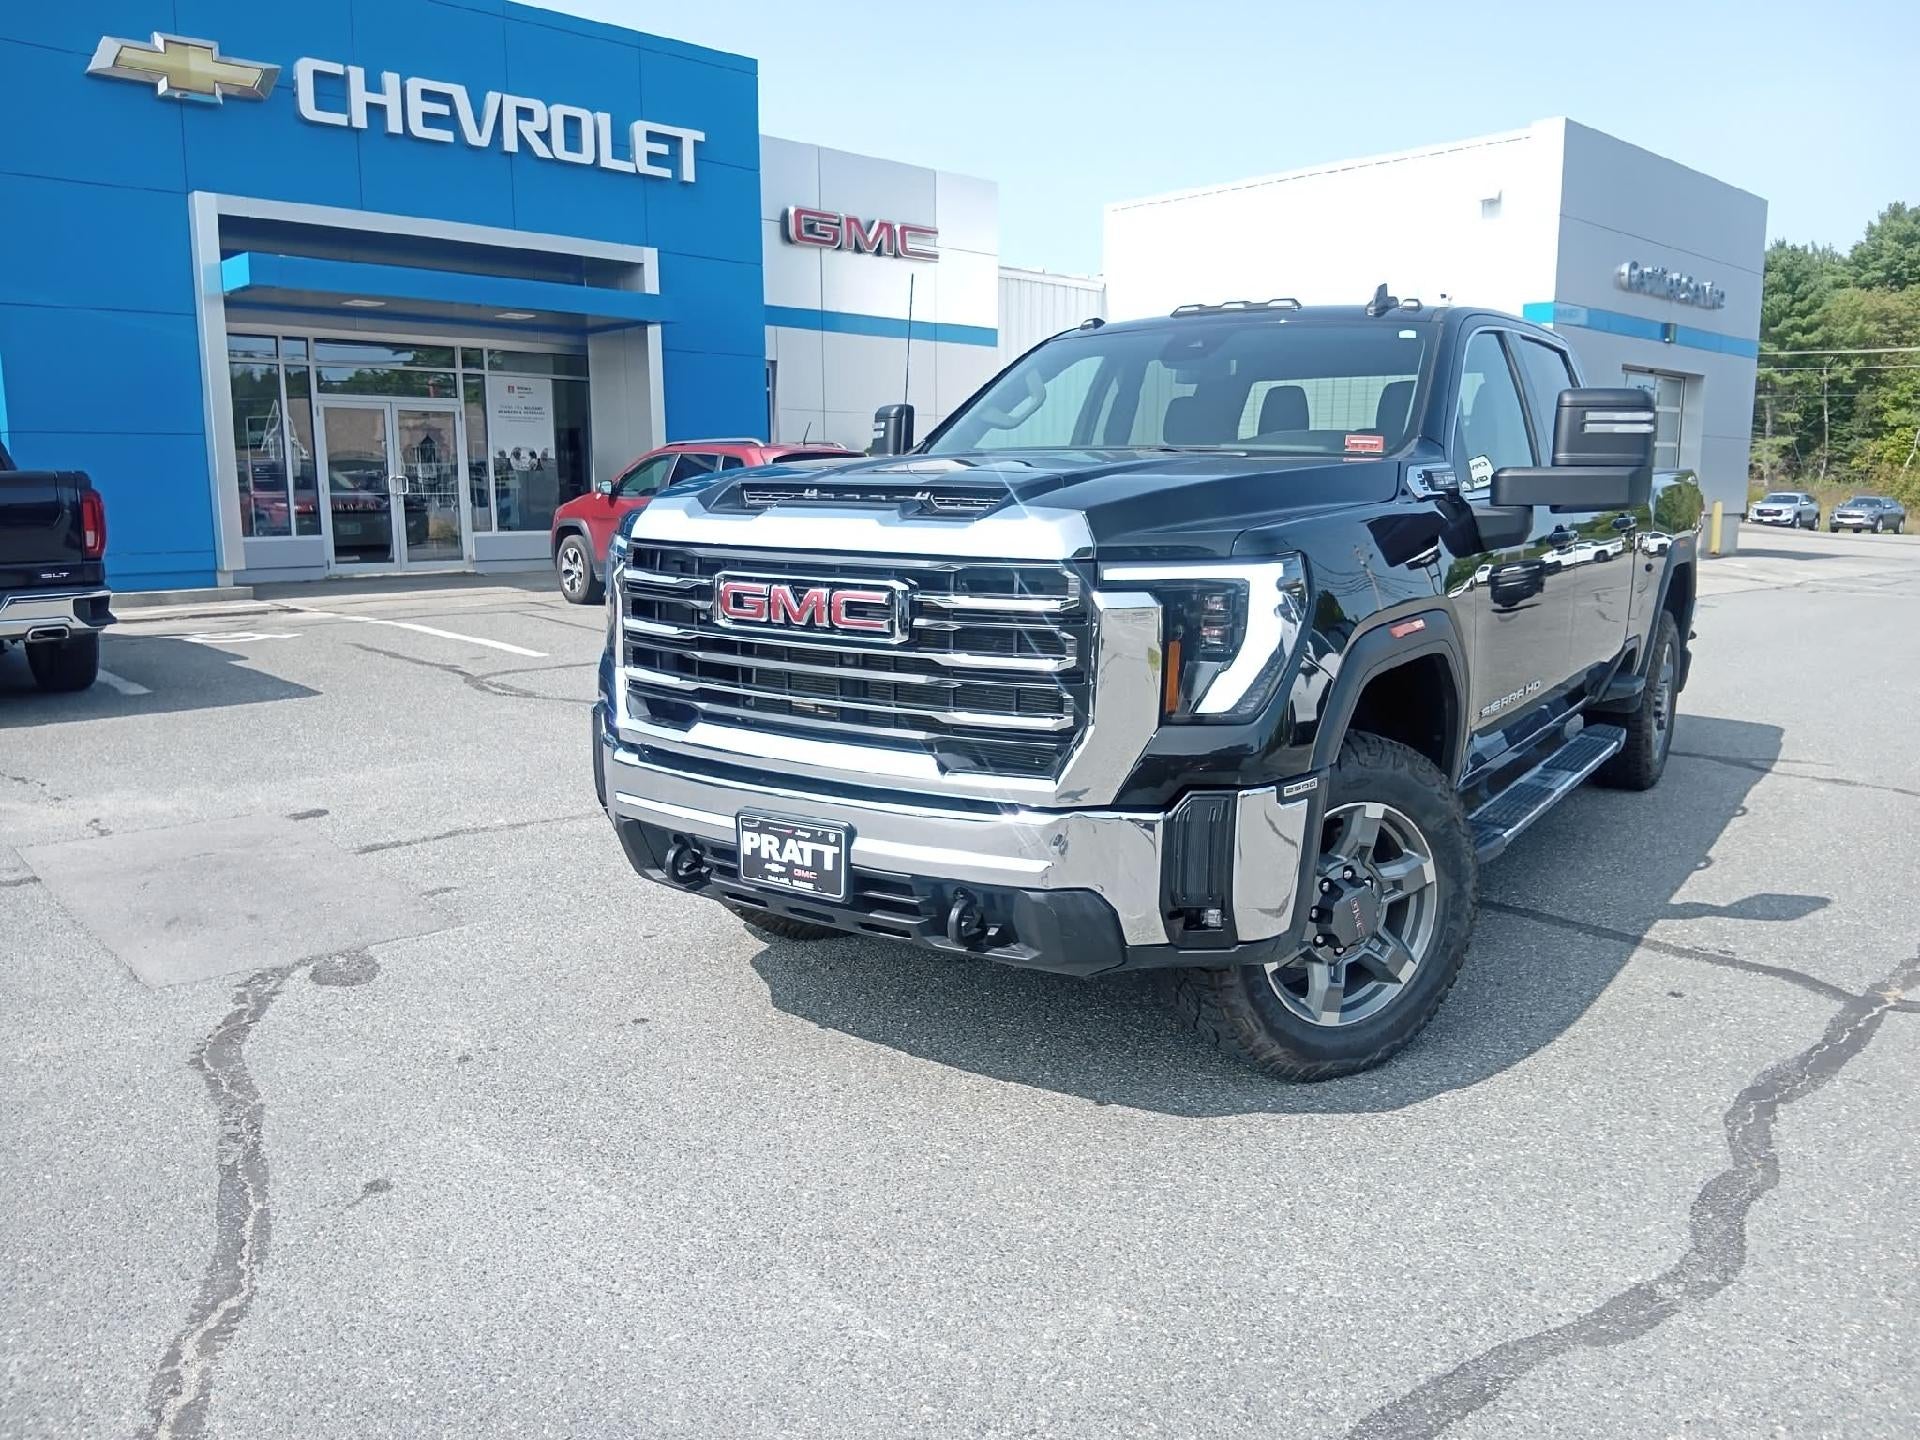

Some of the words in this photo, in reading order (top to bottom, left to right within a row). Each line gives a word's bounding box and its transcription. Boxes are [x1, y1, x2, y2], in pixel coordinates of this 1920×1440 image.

[293, 57, 706, 183] CHEVROLET
[786, 205, 940, 263] GMC
[720, 581, 892, 633] GMC
[1480, 688, 1524, 718] SIERRA
[1525, 680, 1542, 695] HD
[742, 830, 840, 871] PRATT
[793, 868, 818, 880] GMC
